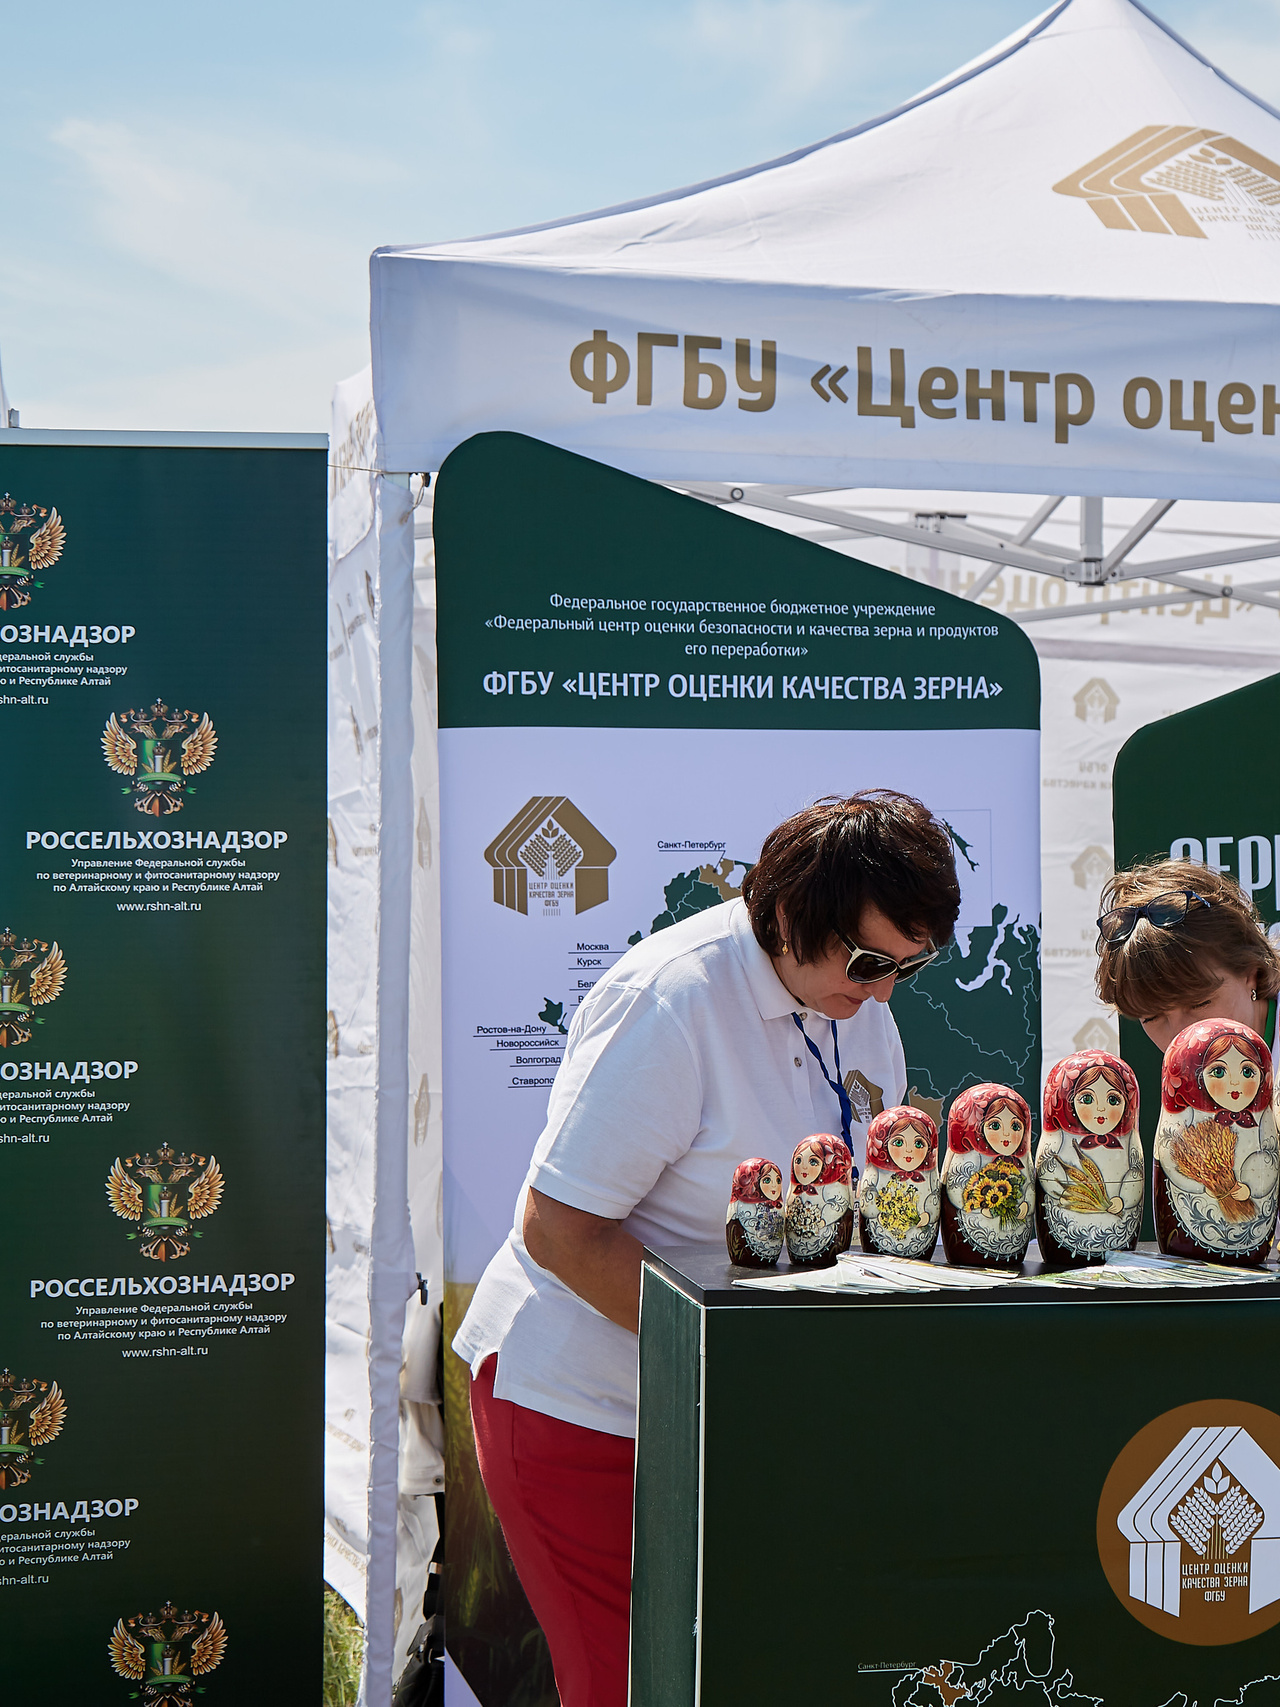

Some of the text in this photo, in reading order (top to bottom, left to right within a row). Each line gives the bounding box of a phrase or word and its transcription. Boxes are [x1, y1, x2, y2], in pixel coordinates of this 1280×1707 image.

[569, 329, 777, 413] ФГБУ
[810, 345, 1096, 444] «Центр
[550, 593, 935, 618] Федеральное государственное бюджетное учреждение
[485, 614, 998, 640] «Федеральный центр оценки безопасности и качества зерна и продуктов
[685, 641, 808, 659] его переработки»
[53, 652, 93, 663] службы
[86, 666, 127, 675] надзору
[18, 676, 78, 687] Республике
[80, 676, 111, 685] Алтай
[483, 670, 1003, 701] ФГБУ «ЦЕНТР ОЦЕНКИ КАЧЕСТВА ЗЕРНА»
[26, 830, 287, 853] РОССЕЛЬХОЗНАДЗОР
[657, 840, 727, 850] Санкт-Петербург
[71, 857, 245, 869] Управление Федеральной службы
[52, 872, 133, 881] ветеринарному
[144, 870, 236, 881] фитосанитарному
[238, 872, 280, 881] надзору
[69, 882, 130, 894] Алтайскому
[133, 884, 160, 893] краю
[171, 882, 230, 893] Республике
[232, 882, 263, 891] Алтай
[528, 882, 574, 891] ЦЕНТР ОЦЕНКИ
[528, 890, 574, 899] КАЧЕСТВА ЗЕРНА
[116, 901, 201, 911] www.rshn-alt.ru
[544, 898, 559, 908] ФГБУ
[576, 943, 610, 951] Москва
[576, 958, 602, 967] Курск
[476, 1025, 547, 1035] Ростов-на-Дону
[496, 1038, 560, 1049] Новороссийск
[516, 1055, 561, 1066] Волгоград
[54, 1088, 95, 1100] службы
[87, 1102, 130, 1111] надзору
[19, 1113, 79, 1125] Республике
[81, 1112, 113, 1122] Алтай
[30, 1273, 295, 1297] РОССЕЛЬХОЗНАДЗОР
[75, 1300, 252, 1316] Управление Федеральной службы
[57, 1319, 138, 1329] ветеринарному
[150, 1315, 243, 1327] фитосанитарному
[245, 1314, 287, 1323] надзору
[73, 1330, 136, 1340] Алтайскому
[138, 1330, 166, 1339] краю
[178, 1326, 237, 1337] Республике
[239, 1324, 270, 1334] Алтай
[121, 1345, 208, 1357] www.rshn-alt.ru
[0, 1527, 95, 1542] еральной службы
[87, 1539, 130, 1549] надзору
[18, 1554, 79, 1565] Республике
[81, 1550, 113, 1561] Алтай
[1182, 1562, 1249, 1576] ЦЕНТР ОЦЕНКИ
[1182, 1575, 1248, 1589] КАЧЕСТВА ЗЕРНА
[1204, 1590, 1226, 1602] ФГБУ
[857, 1661, 916, 1670] Санкт-Петербург
